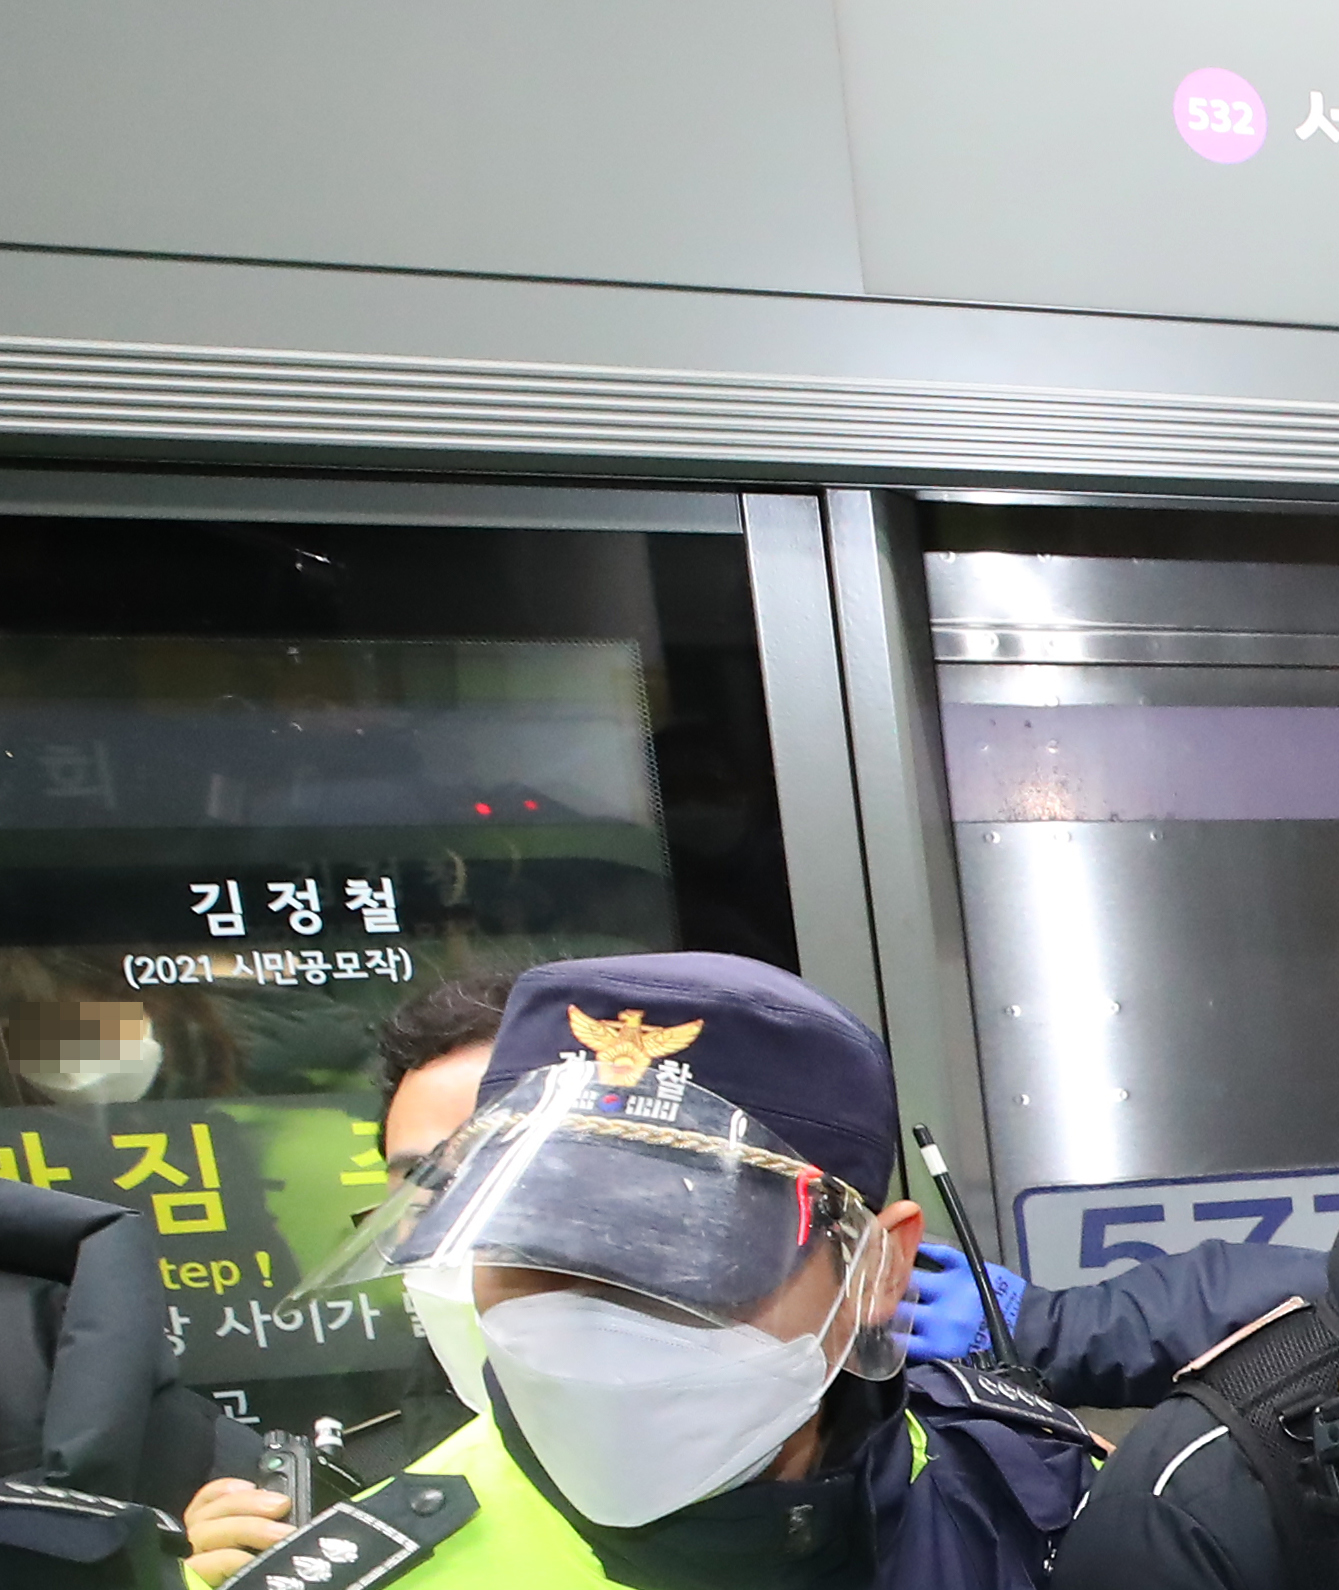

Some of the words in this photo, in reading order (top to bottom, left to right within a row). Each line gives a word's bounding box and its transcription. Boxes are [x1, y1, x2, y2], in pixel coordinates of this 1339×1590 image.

[1187, 97, 1255, 136] 532
[124, 954, 211, 988] (2021
[233, 947, 412, 986] 시민공모작)
